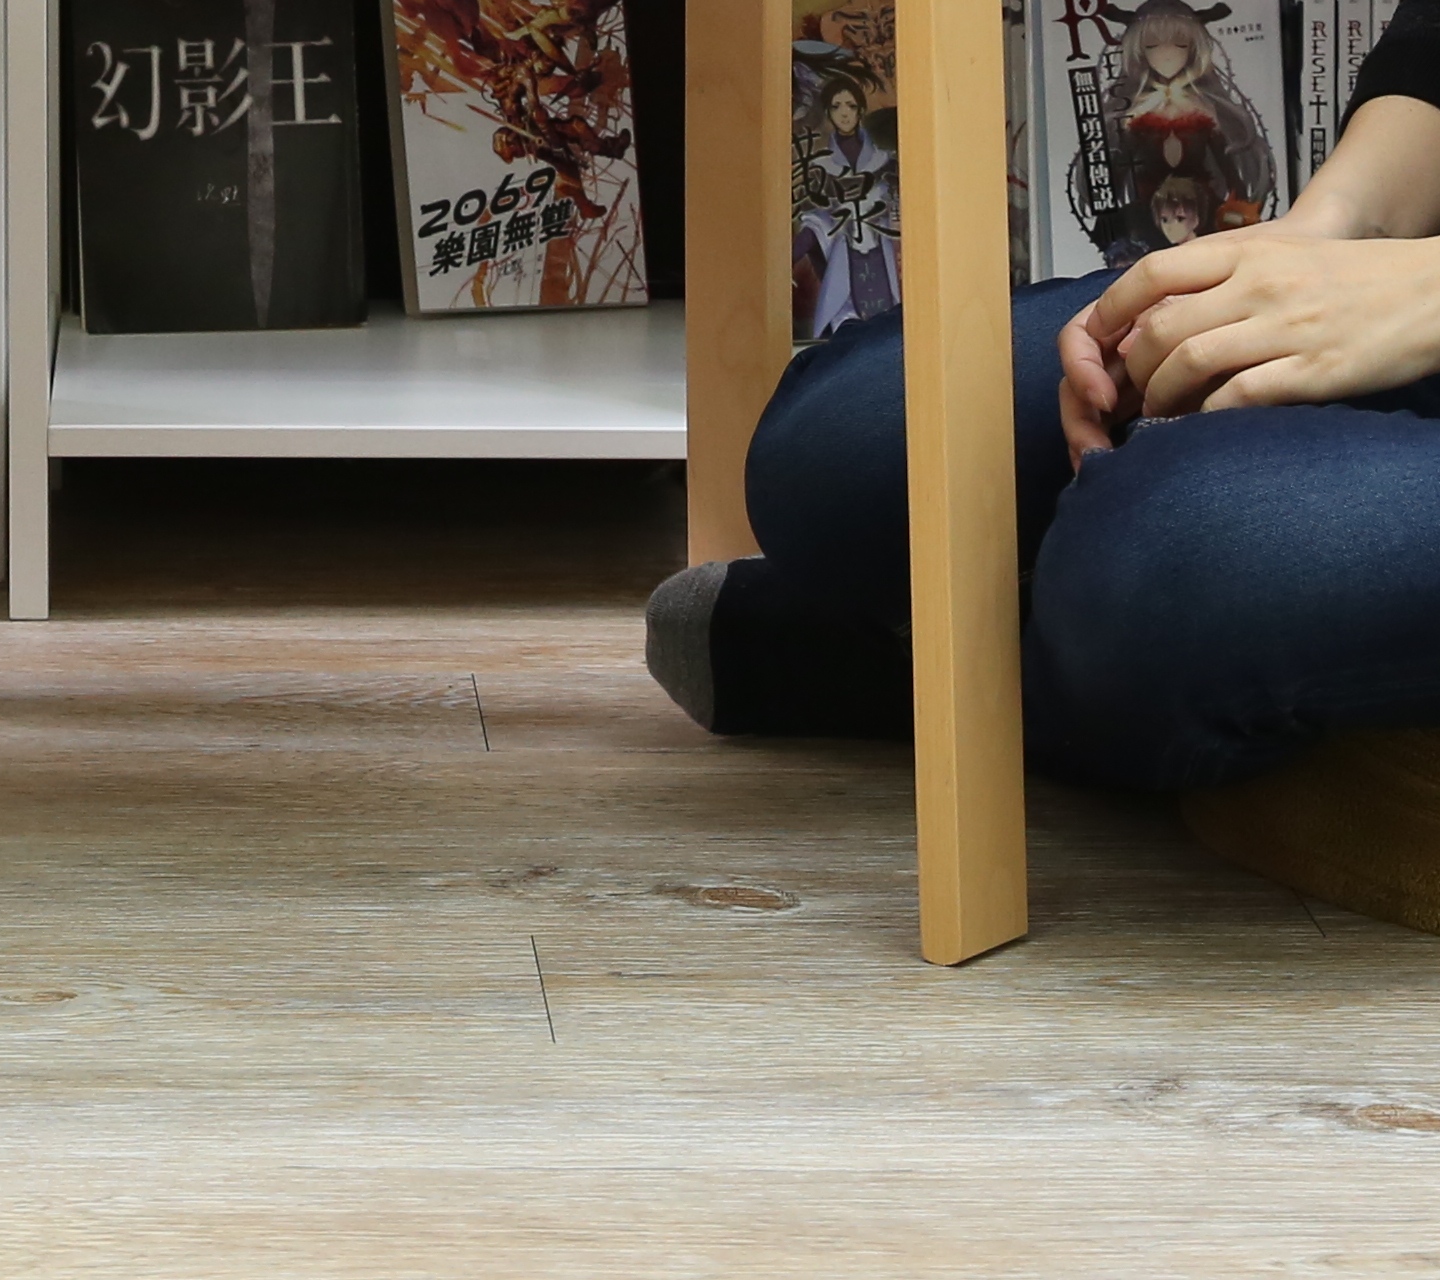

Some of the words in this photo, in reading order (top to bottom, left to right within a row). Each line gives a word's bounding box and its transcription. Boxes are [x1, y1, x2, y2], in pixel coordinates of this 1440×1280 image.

[85, 37, 343, 141] 幻影王
[417, 166, 557, 239] 2069
[428, 198, 575, 277] 樂園無雙
